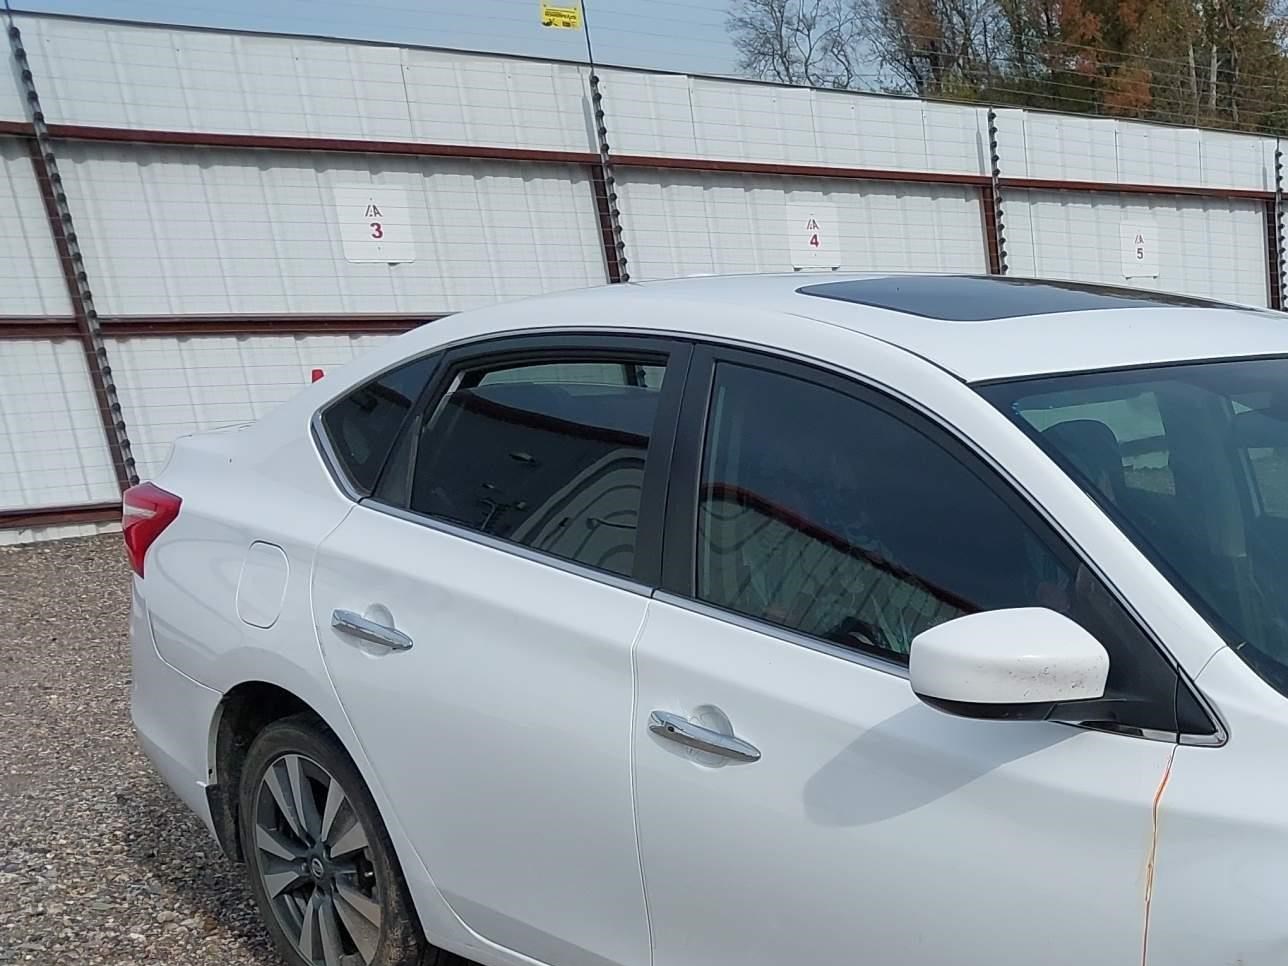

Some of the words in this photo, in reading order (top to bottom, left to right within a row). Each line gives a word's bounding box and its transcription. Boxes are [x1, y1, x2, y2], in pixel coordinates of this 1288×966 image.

[369, 222, 384, 239] 3
[809, 233, 820, 248] 4
[1137, 247, 1144, 260] 5
